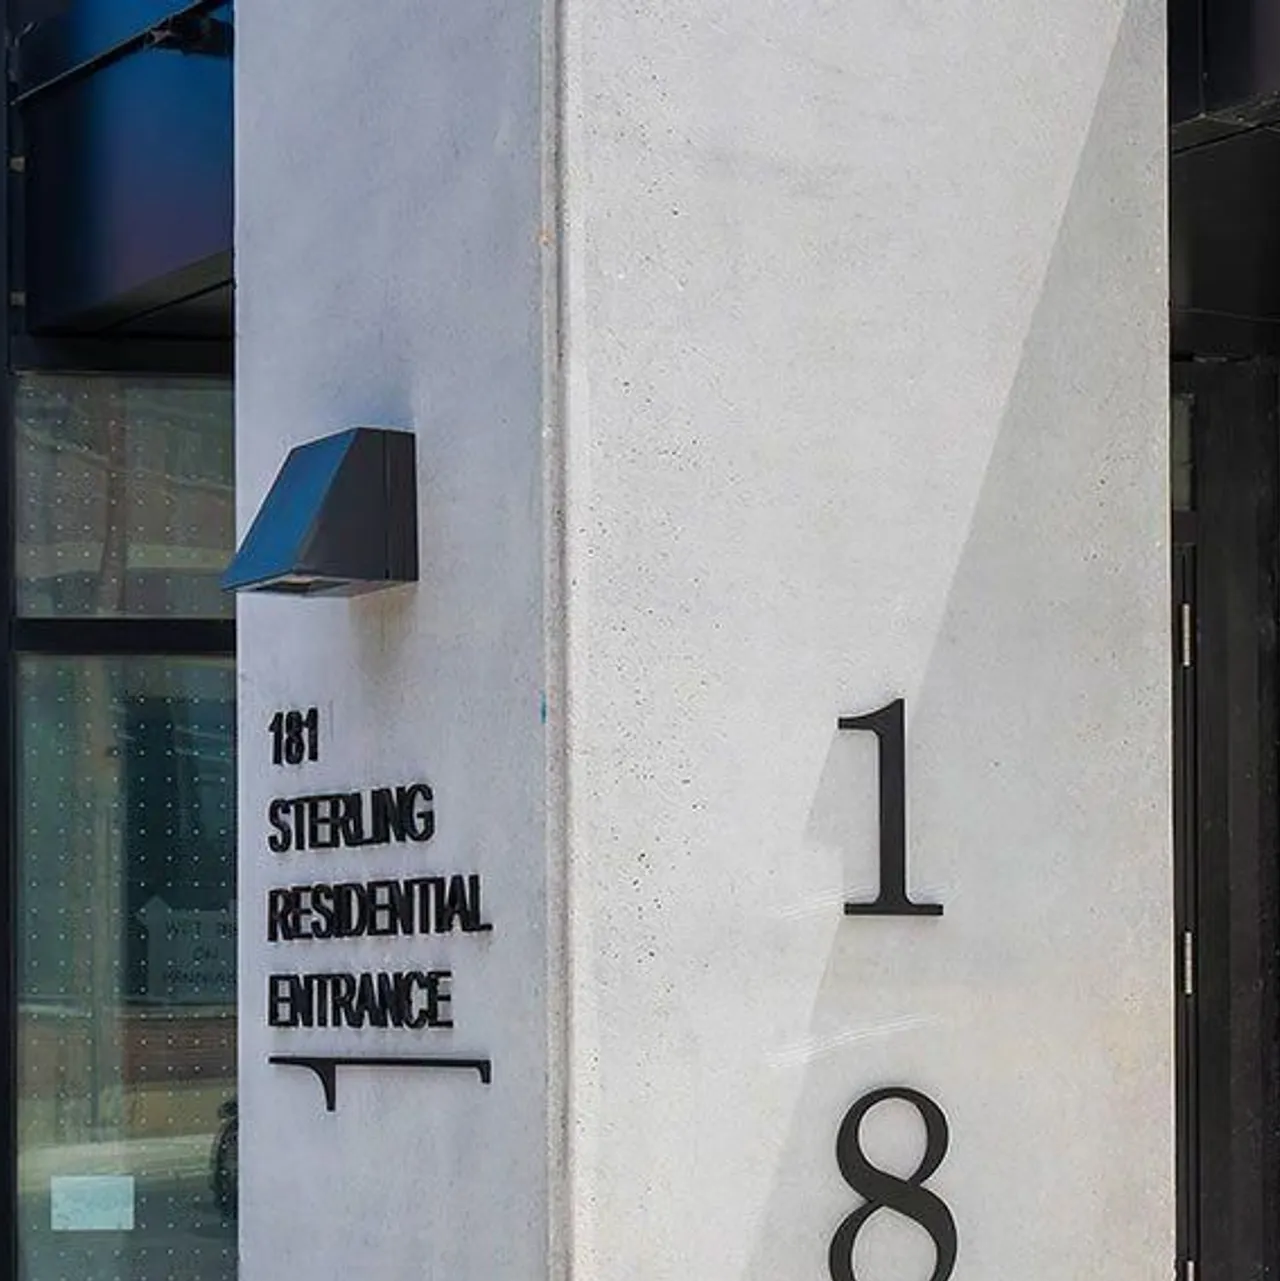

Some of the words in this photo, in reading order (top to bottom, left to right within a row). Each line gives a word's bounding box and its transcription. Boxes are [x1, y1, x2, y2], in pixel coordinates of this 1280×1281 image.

[268, 707, 319, 766] 181
[267, 783, 435, 854] STERLING
[267, 874, 493, 942] RESIDENTIAL
[267, 970, 454, 1029] ENTRANCE
